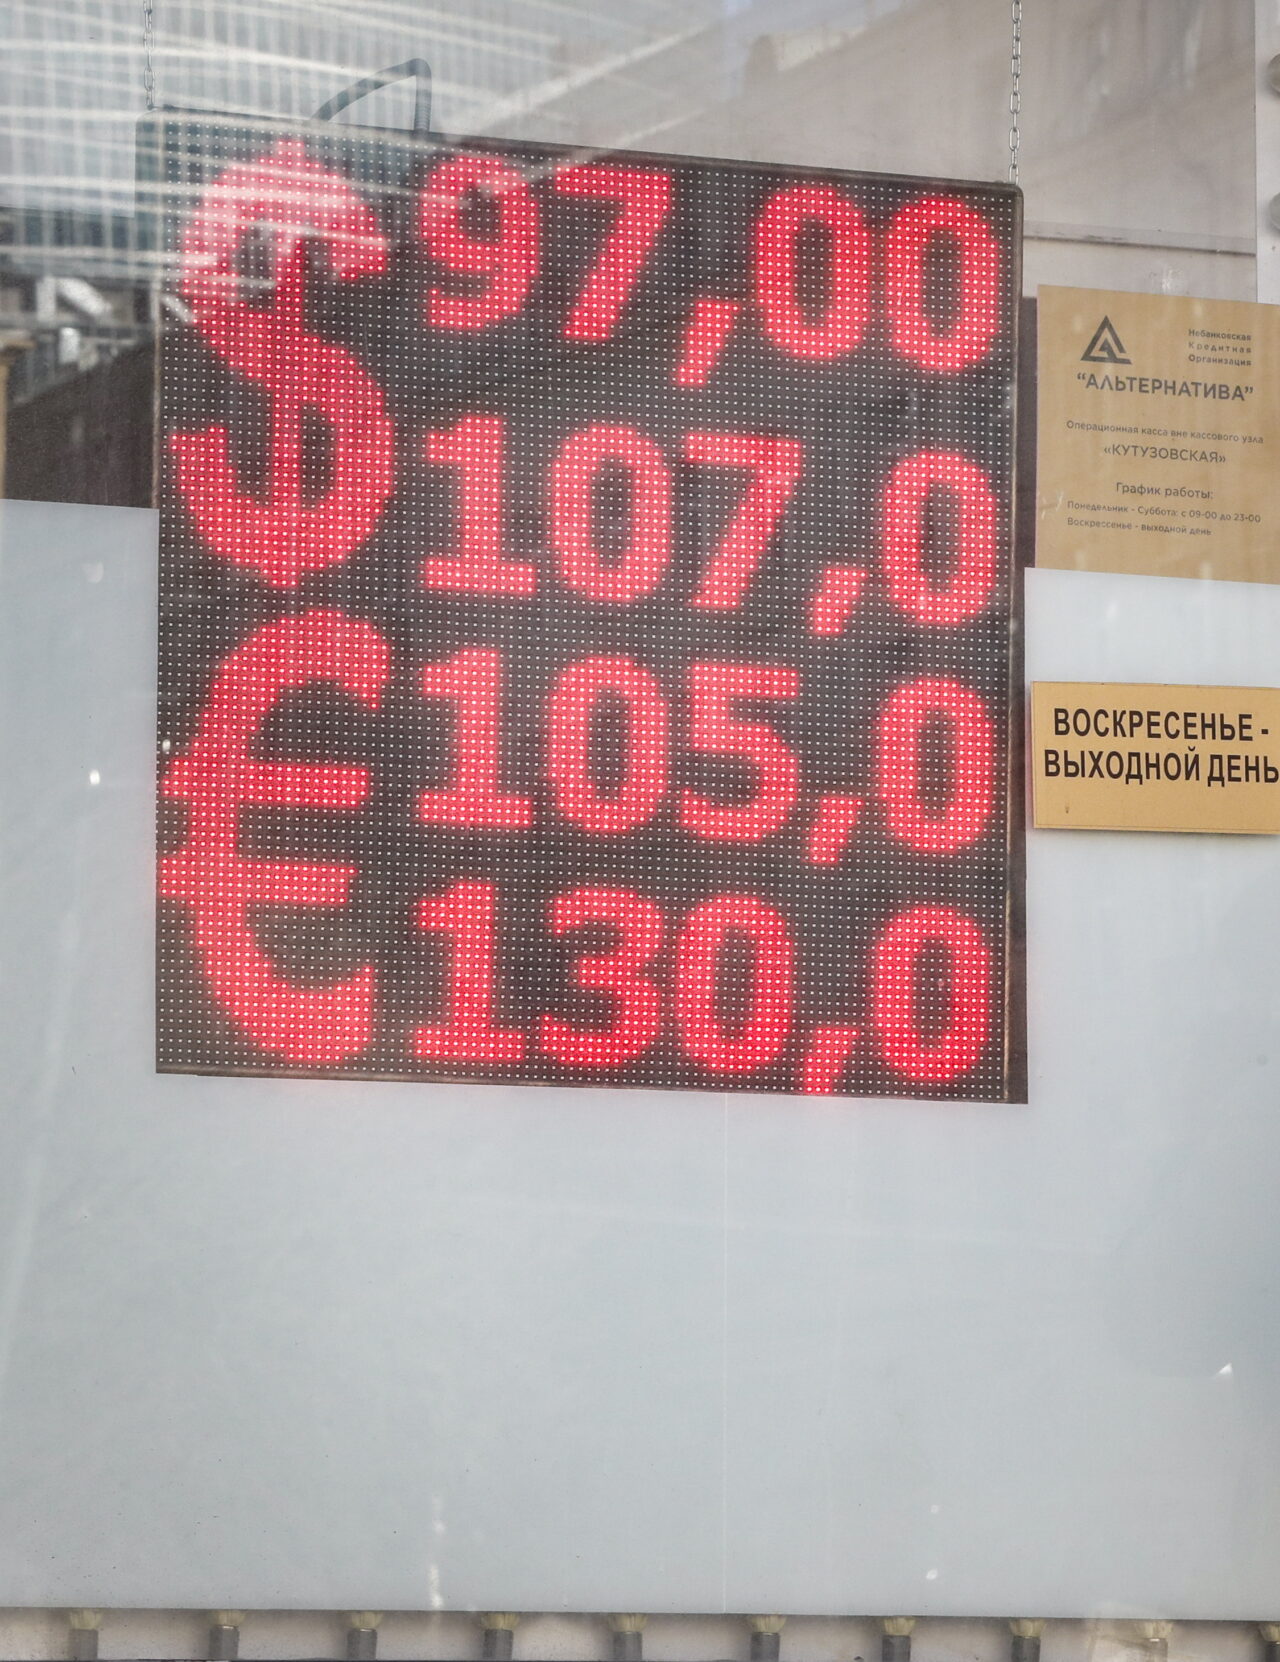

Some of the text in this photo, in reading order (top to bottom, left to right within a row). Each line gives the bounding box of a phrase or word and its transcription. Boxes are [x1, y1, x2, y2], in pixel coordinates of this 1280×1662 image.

[419, 152, 1001, 388] 97,00
[169, 138, 394, 590] $
[1188, 353, 1252, 367] Организация
[1066, 420, 1264, 444] Операционная касса вне кассового узла
[1103, 444, 1226, 463] «КУТУЗОВСКАЯ»
[1116, 482, 1214, 500] График работы:
[423, 414, 1001, 637] 107,0
[1067, 500, 1128, 513] Понедельник
[1137, 506, 1178, 516] Суббота:
[1188, 509, 1218, 520] 09-00
[1219, 513, 1232, 521] до
[1233, 513, 1261, 523] 23-00
[1141, 523, 1187, 533] выходной
[1189, 528, 1212, 536] день
[1053, 707, 1254, 742] ВОСКРЕСЕНЬЕ
[417, 646, 998, 866] 105,0
[1043, 745, 1280, 787] ВЫХОДНОЙ ДЕНЬ
[159, 610, 391, 1066] €
[411, 881, 993, 1096] 130,0
